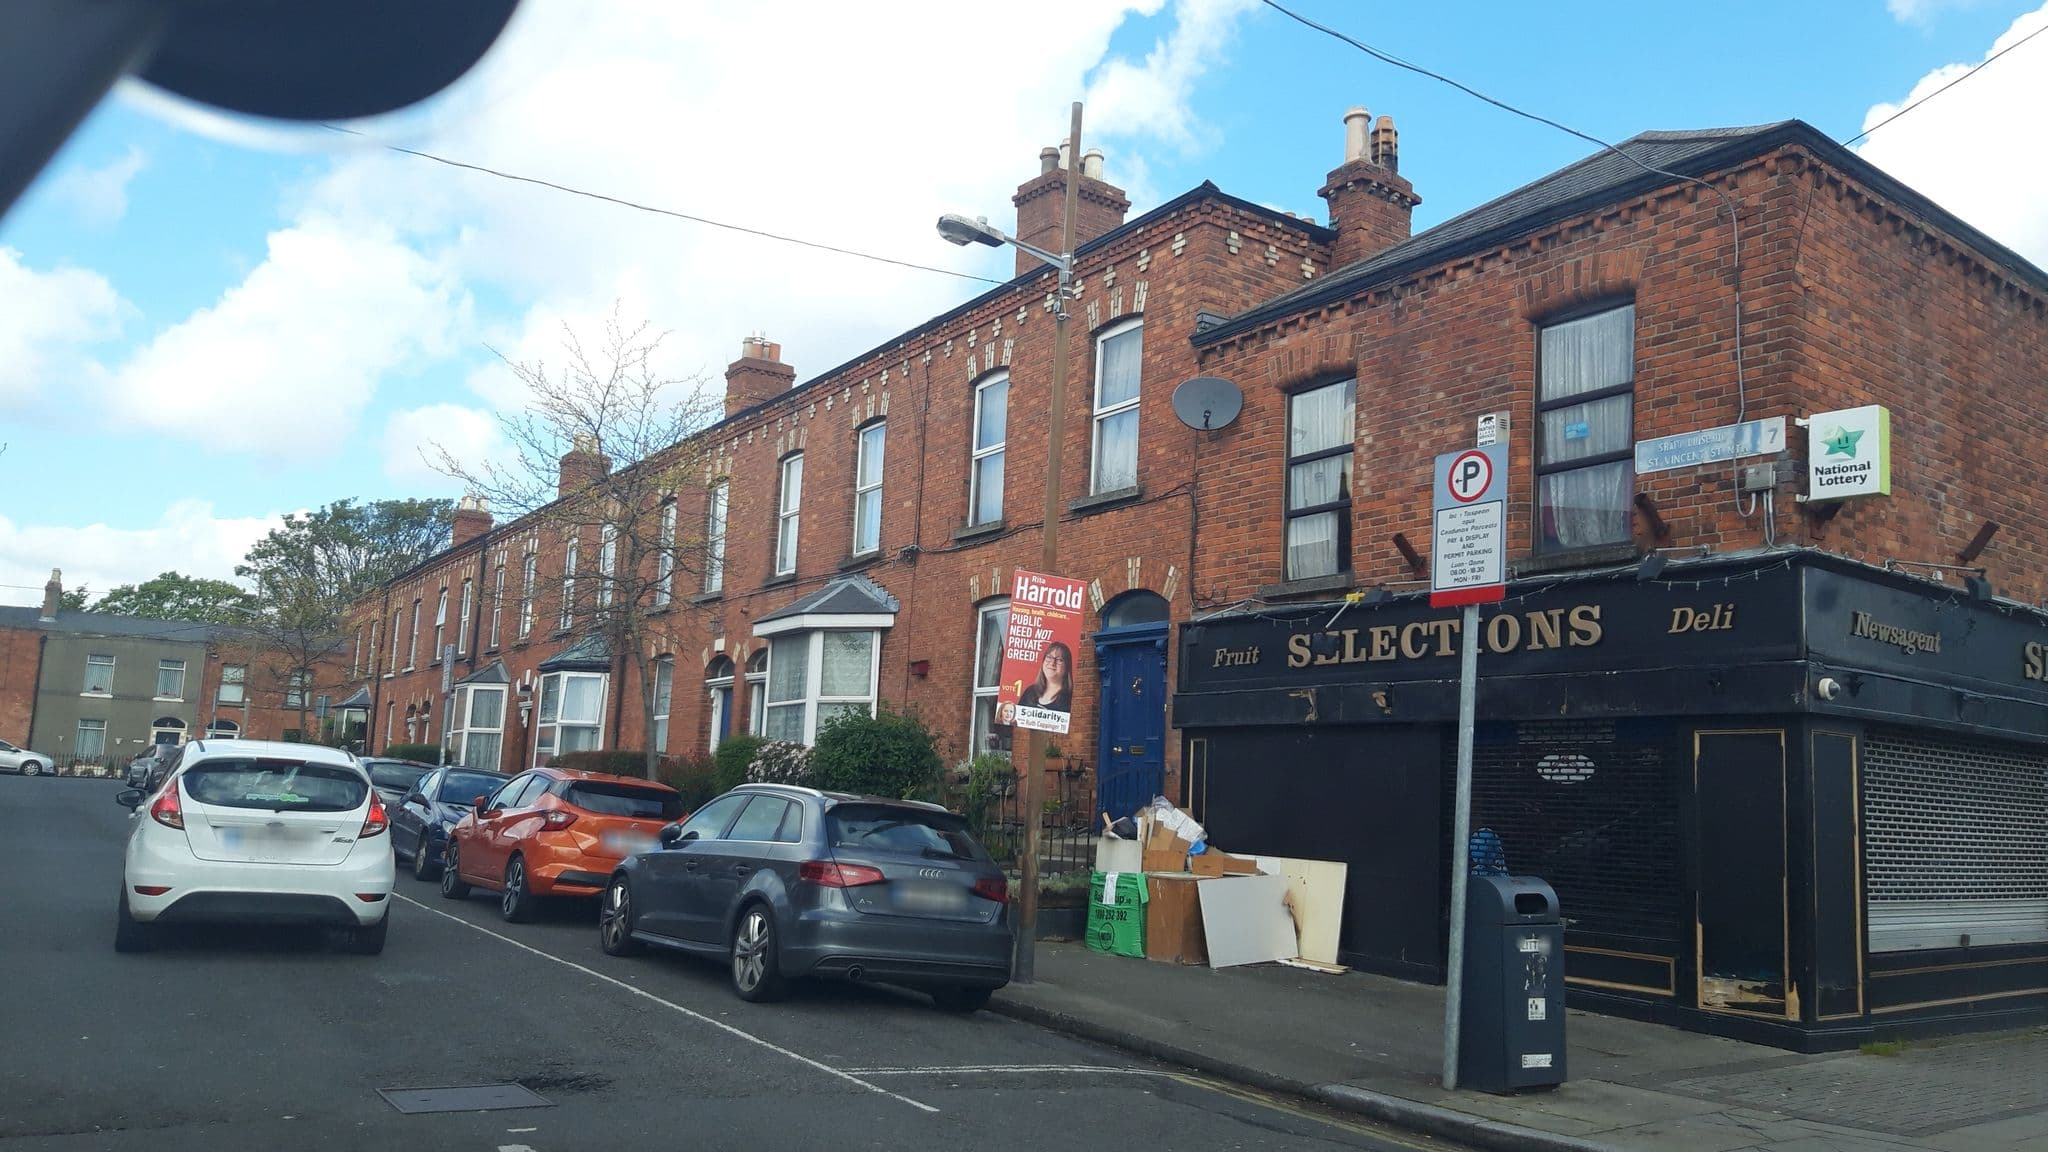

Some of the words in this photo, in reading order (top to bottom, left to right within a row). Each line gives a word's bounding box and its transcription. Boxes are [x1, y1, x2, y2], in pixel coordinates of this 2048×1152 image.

[1767, 427, 1778, 444] 7
[1815, 460, 1871, 476] National
[1462, 460, 1480, 494] P
[1819, 473, 1868, 487] Lottery
[1465, 533, 1489, 541] DISPLAY
[1443, 551, 1464, 559] PERMIT
[1466, 548, 1493, 556] PARKING
[1032, 575, 1046, 584] Rita
[1015, 576, 1083, 609] Harrold
[1011, 613, 1042, 627] PUBLIC
[1667, 602, 1735, 634] Deli
[1010, 625, 1032, 638] NEED
[1034, 628, 1054, 640] NOT
[1287, 604, 1603, 669] SLECTONS
[1852, 610, 1942, 654] Newsagent
[1008, 636, 1043, 651] PRIVATE
[1007, 648, 1039, 662] GREED!
[1212, 646, 1260, 668] Fruit
[2023, 640, 2048, 682] S
[1014, 679, 1022, 697] 1
[1020, 708, 1062, 722] Solidarity
